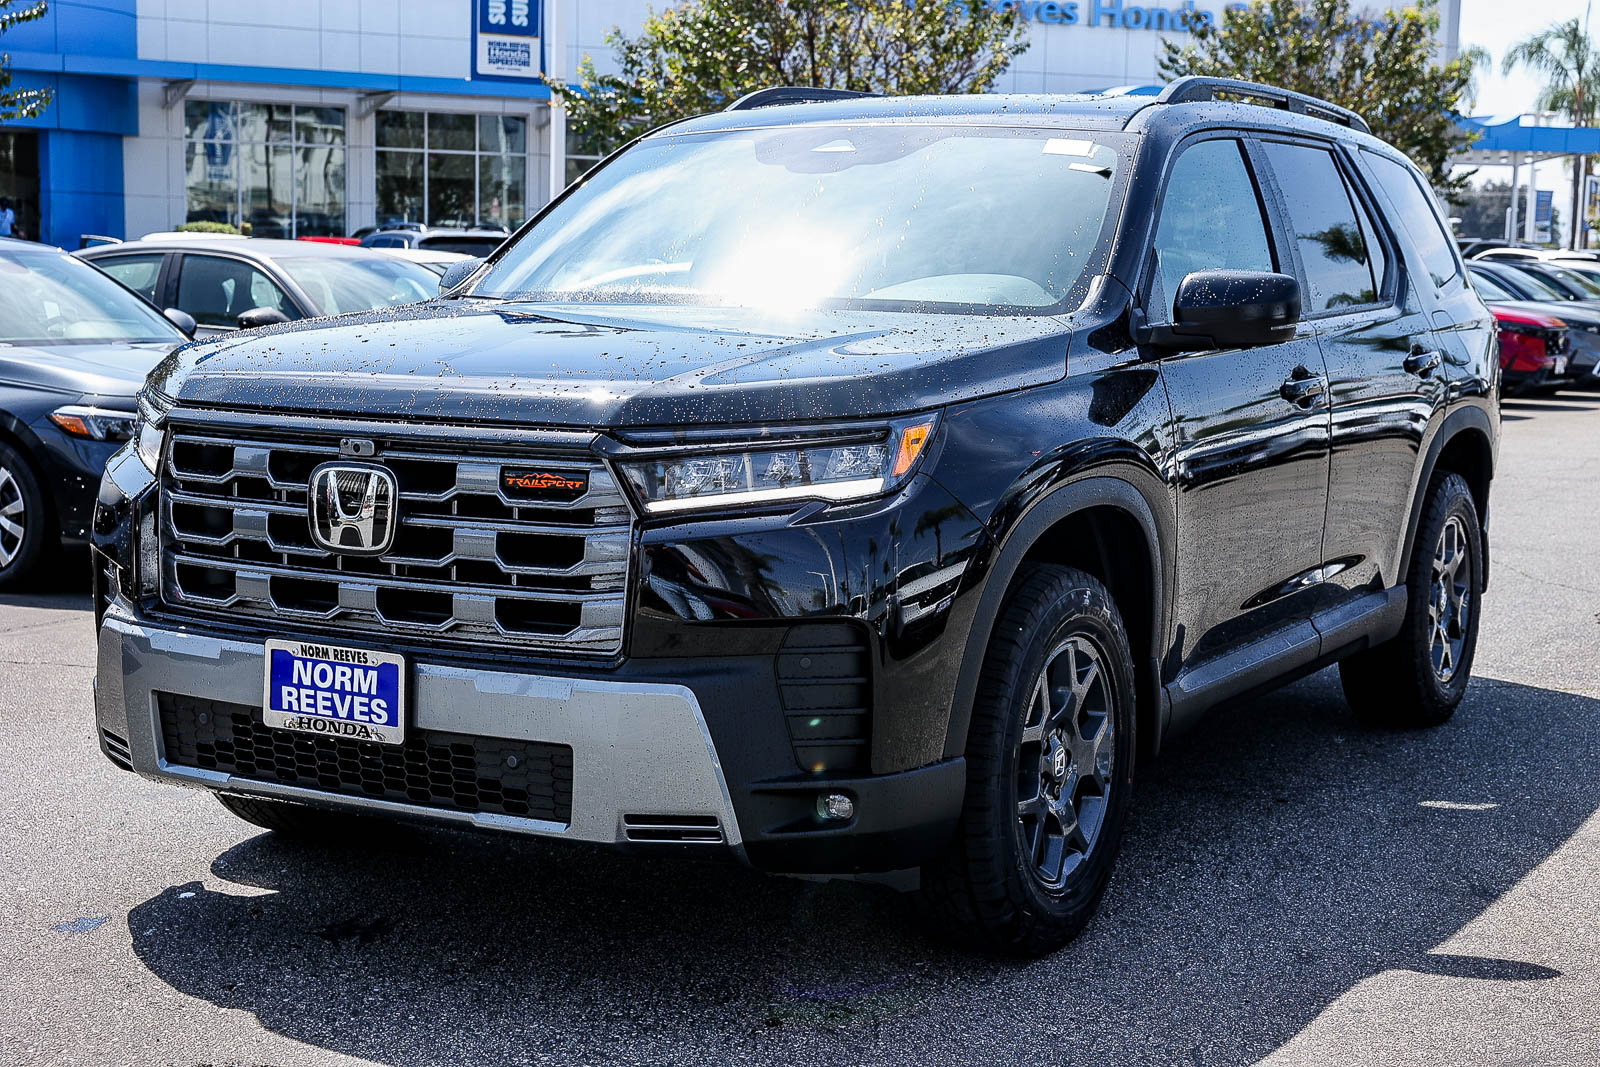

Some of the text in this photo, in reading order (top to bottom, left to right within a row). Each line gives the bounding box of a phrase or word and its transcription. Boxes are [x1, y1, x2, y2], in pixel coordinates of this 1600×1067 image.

[488, 0, 506, 25] SU
[512, 0, 529, 27] SU
[506, 478, 584, 489] TRAILSPORT
[300, 645, 368, 664] NORM REEVES
[292, 660, 378, 695] NORM
[281, 686, 389, 724] REEVES
[298, 717, 373, 739] HONDA
